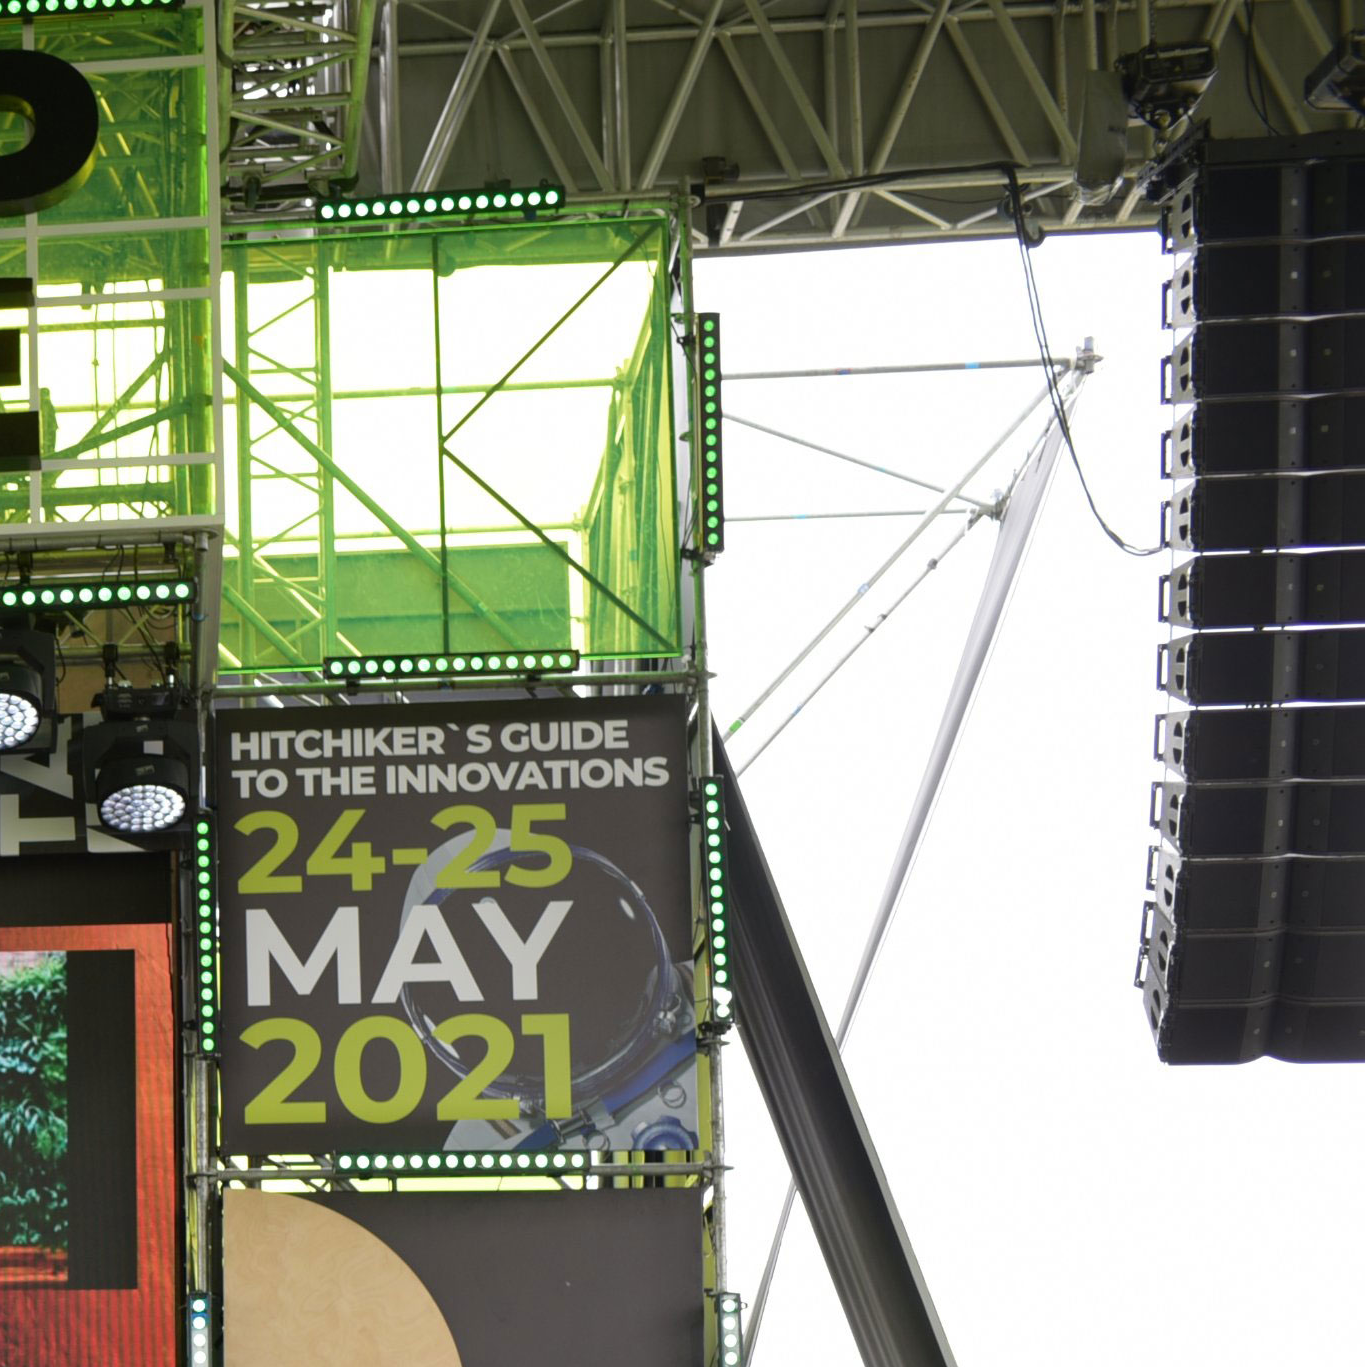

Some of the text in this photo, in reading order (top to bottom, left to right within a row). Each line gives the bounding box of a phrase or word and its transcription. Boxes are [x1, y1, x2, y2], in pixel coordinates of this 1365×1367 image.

[231, 756, 670, 798] TO THE INNOVATIONS
[500, 719, 629, 752] GUIDE
[233, 803, 573, 894] 24-25
[245, 900, 574, 1007] MAY
[238, 1013, 573, 1125] 2021
